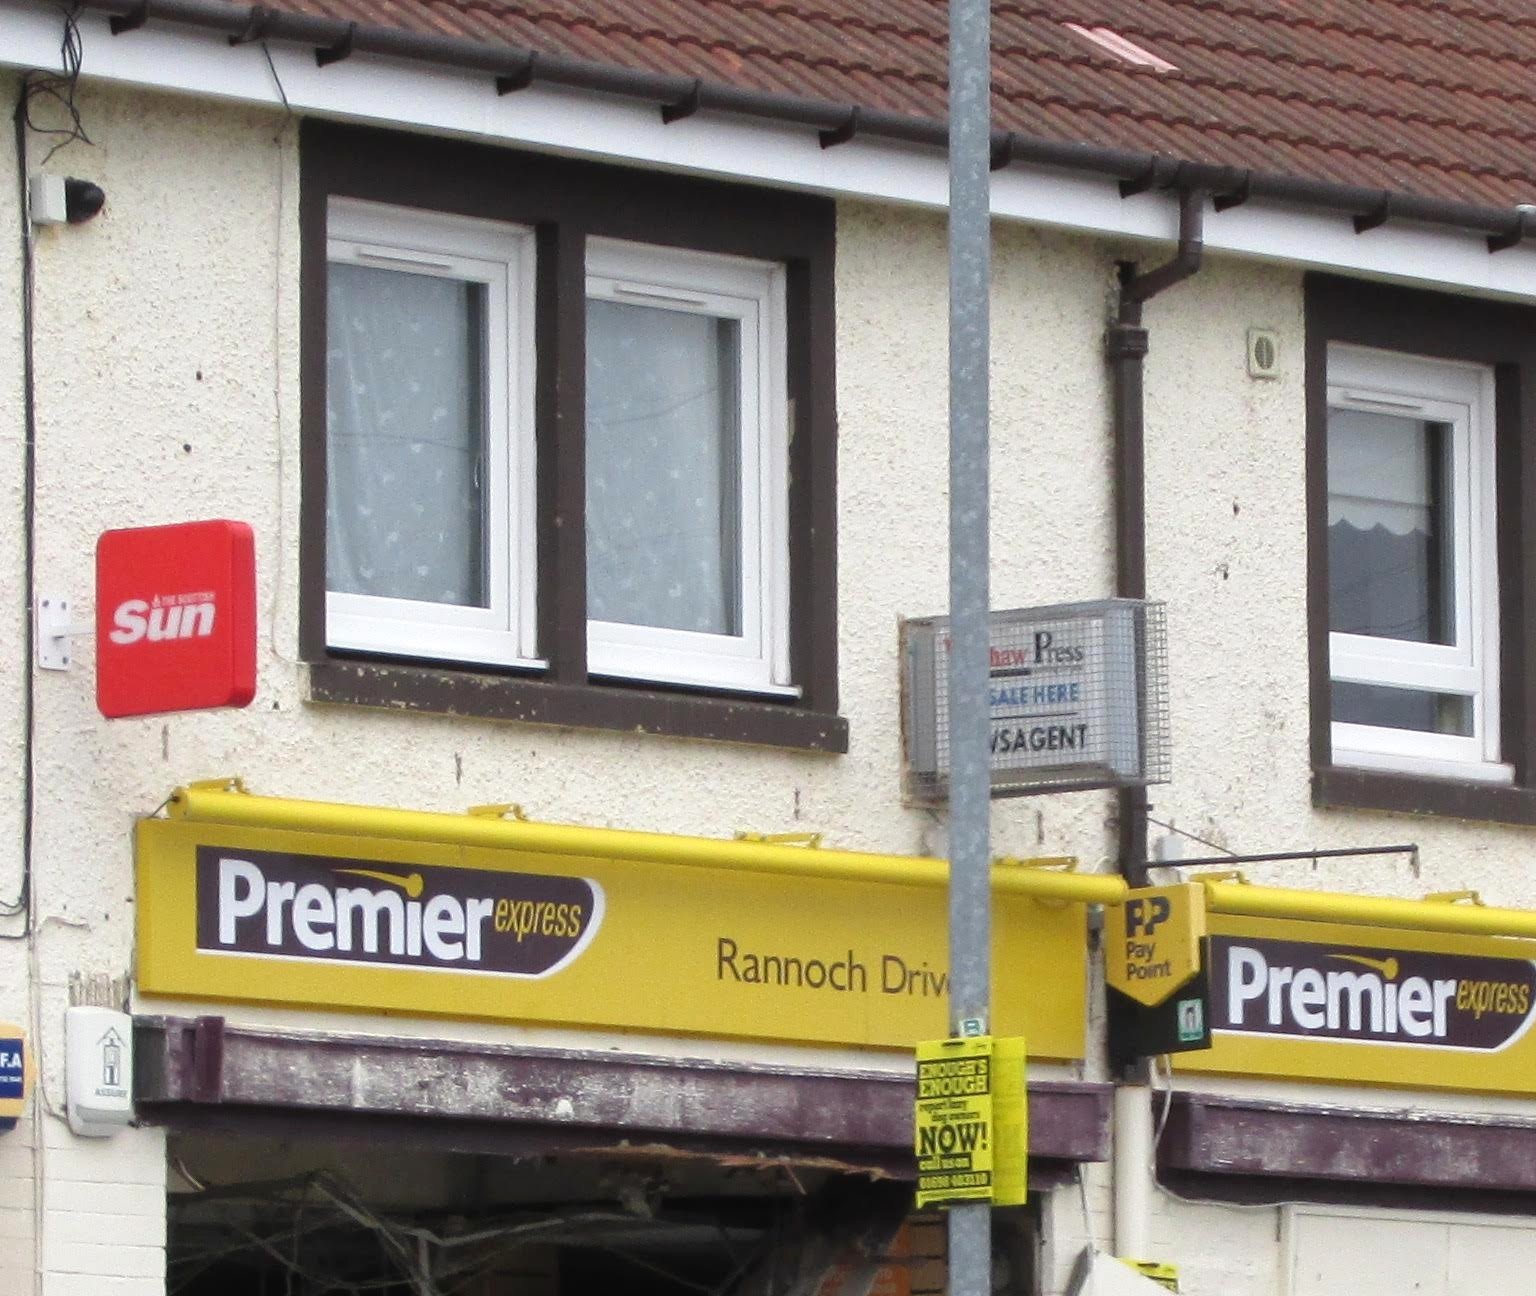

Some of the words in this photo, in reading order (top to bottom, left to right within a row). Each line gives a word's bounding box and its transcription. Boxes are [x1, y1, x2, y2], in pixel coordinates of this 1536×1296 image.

[109, 599, 216, 645] Sun
[1034, 631, 1085, 664] Press
[990, 686, 1029, 706] SALE
[1033, 682, 1081, 703] HERE
[219, 857, 494, 962] Premier
[494, 898, 582, 943] express
[717, 937, 867, 993] Rannoch
[882, 954, 951, 998] Driv
[1127, 941, 1156, 962] Pay
[1127, 961, 1172, 981] Point
[1227, 945, 1457, 1037] Premier
[1456, 978, 1531, 1019] express
[919, 1074, 987, 1098] ENOUGH
[920, 1122, 989, 1156] NOW!
